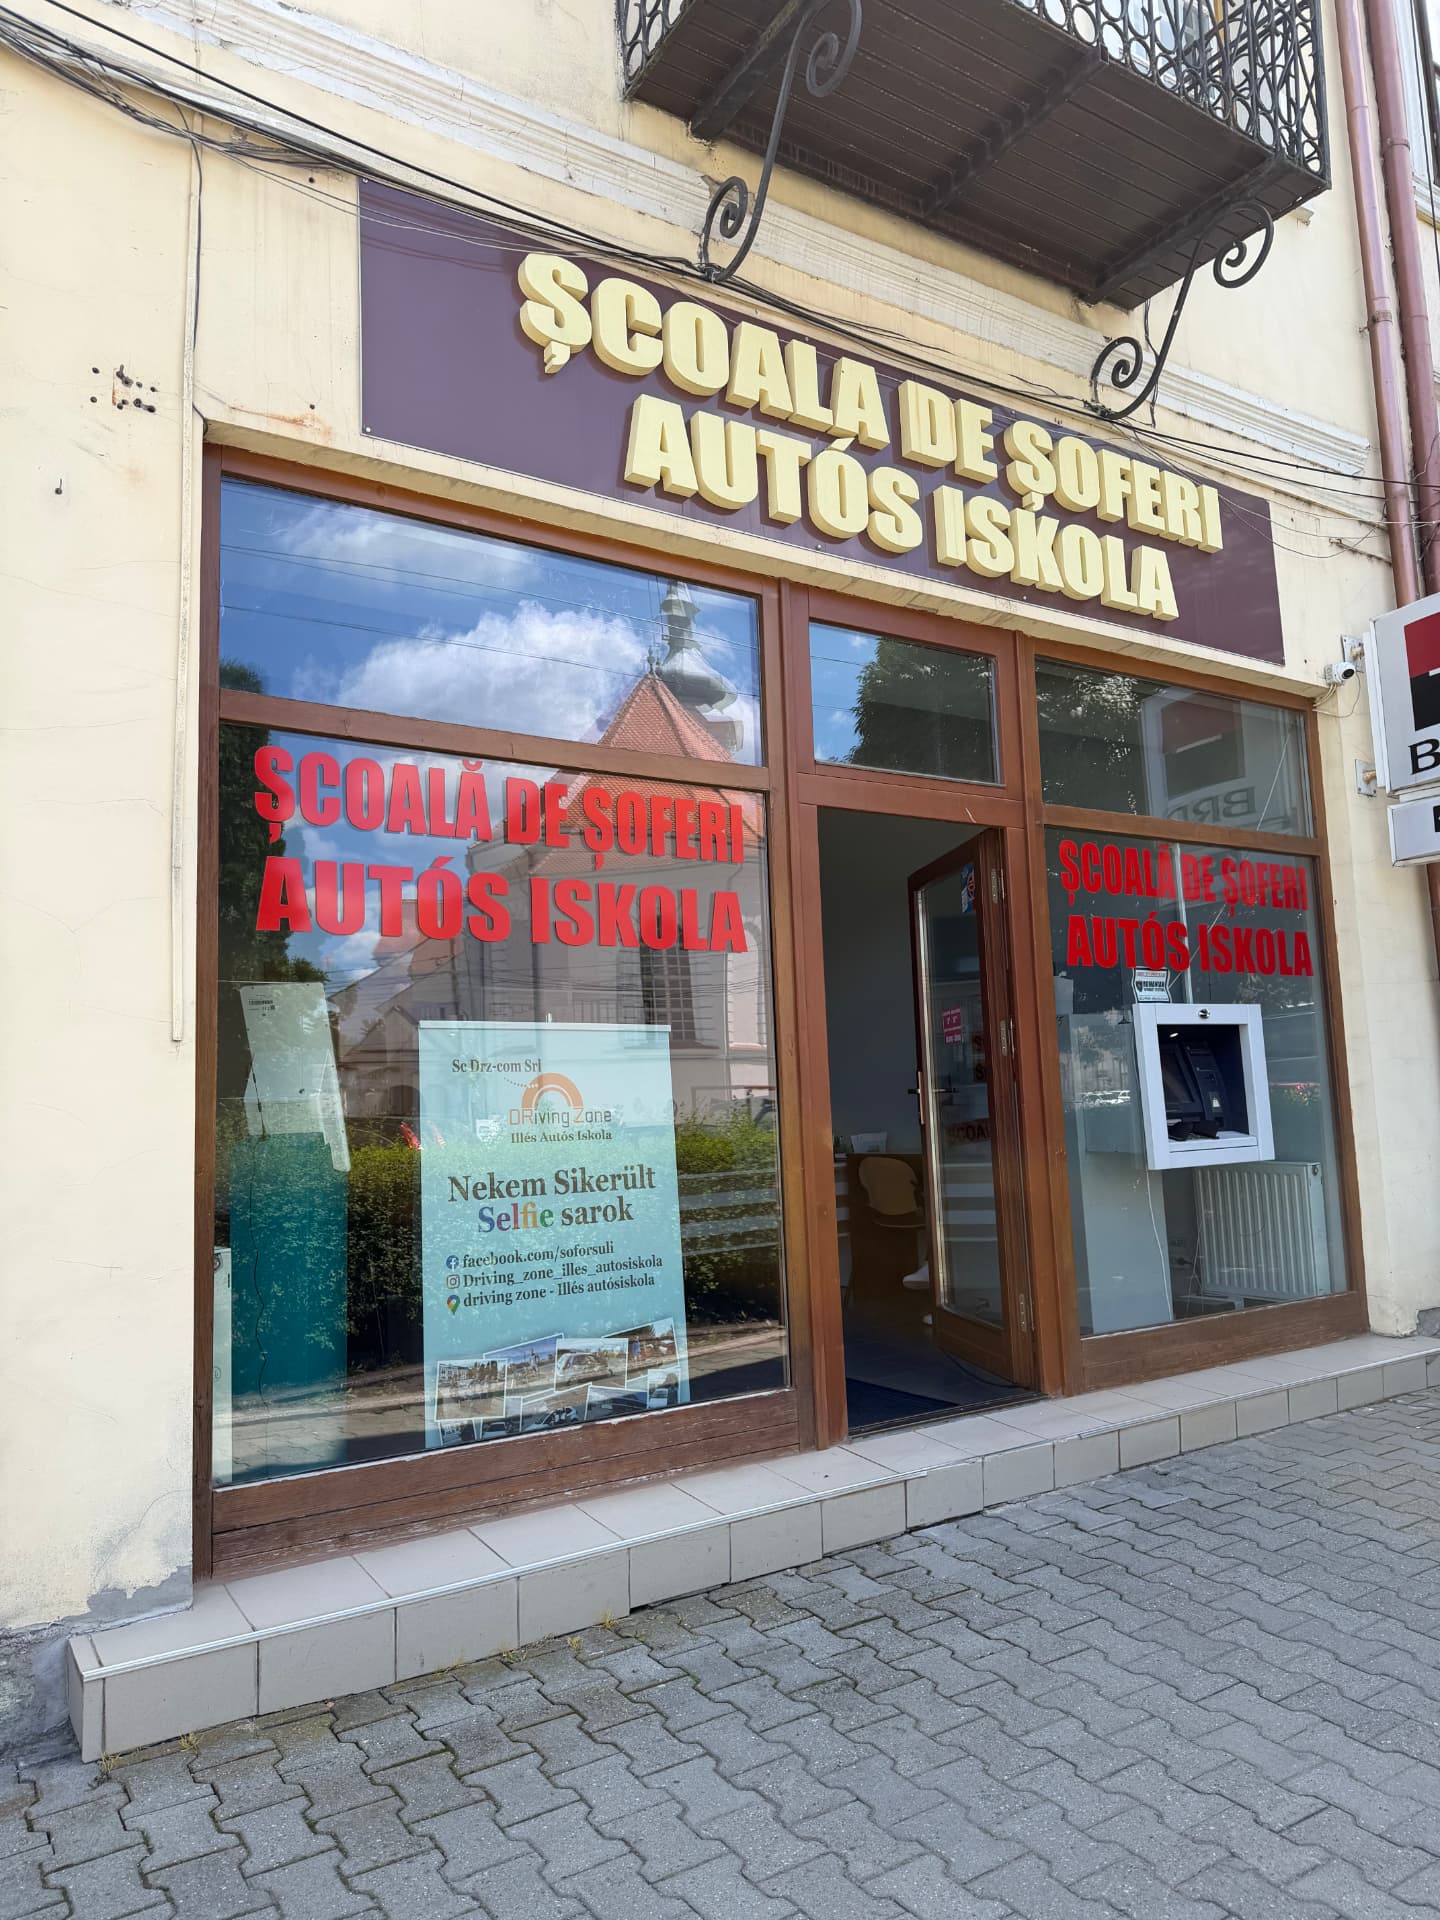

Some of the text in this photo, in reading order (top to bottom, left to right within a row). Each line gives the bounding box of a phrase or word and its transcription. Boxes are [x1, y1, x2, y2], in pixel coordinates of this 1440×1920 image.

[898, 379, 999, 484] DE
[624, 393, 1178, 621] AUTÓS ISKOLA
[506, 776, 569, 848] DE
[1181, 853, 1216, 903] DE
[256, 856, 748, 953] AUTÓS ISKOLA
[1066, 911, 1313, 977] AUTÓS ISKOLA
[452, 1058, 542, 1073] Sc Drz-com Srl
[509, 1107, 612, 1127] DRiving Zone
[511, 1129, 612, 1143] Illés Autós Iskola
[448, 1164, 656, 1202] Nekem Sikerült
[478, 1196, 634, 1233] Selfie sarok
[463, 1241, 614, 1268] facebook.com/soforsuli
[463, 1255, 663, 1287] Driving_zone_illes_autosiskola
[463, 1290, 513, 1307] driving
[515, 1288, 546, 1301] zone
[557, 1282, 584, 1296] Illés
[587, 1273, 655, 1292] autósiskola
